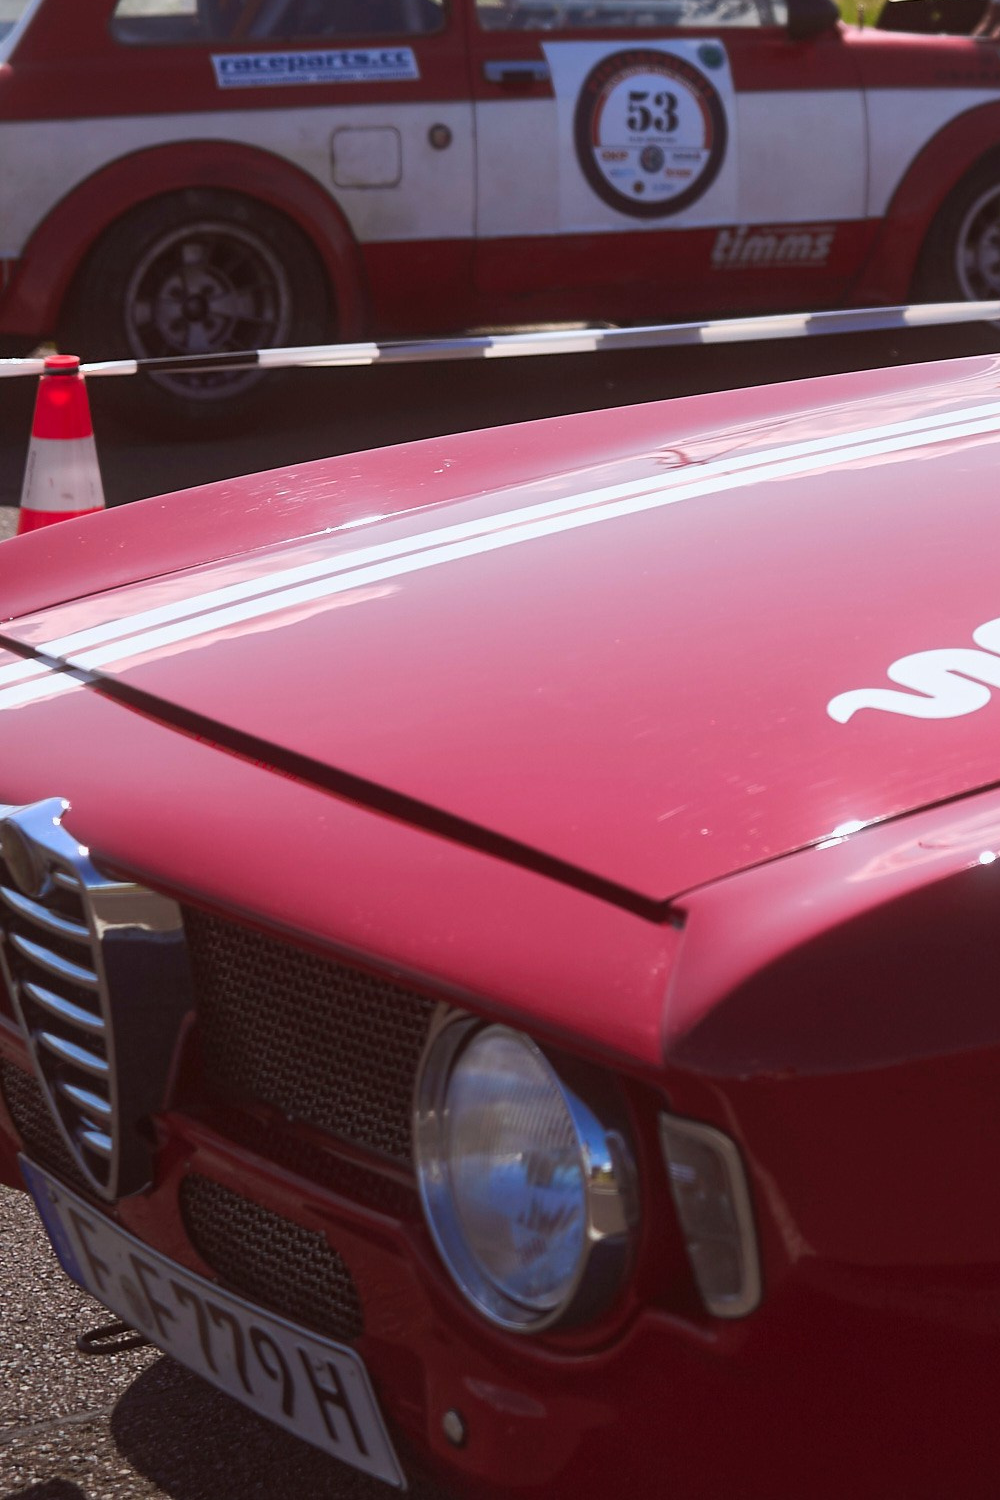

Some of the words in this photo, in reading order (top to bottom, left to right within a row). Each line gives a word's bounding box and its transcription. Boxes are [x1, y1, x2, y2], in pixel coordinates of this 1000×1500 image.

[220, 52, 410, 73] raceparts.cc
[626, 90, 679, 133] 53
[711, 225, 832, 262] timms
